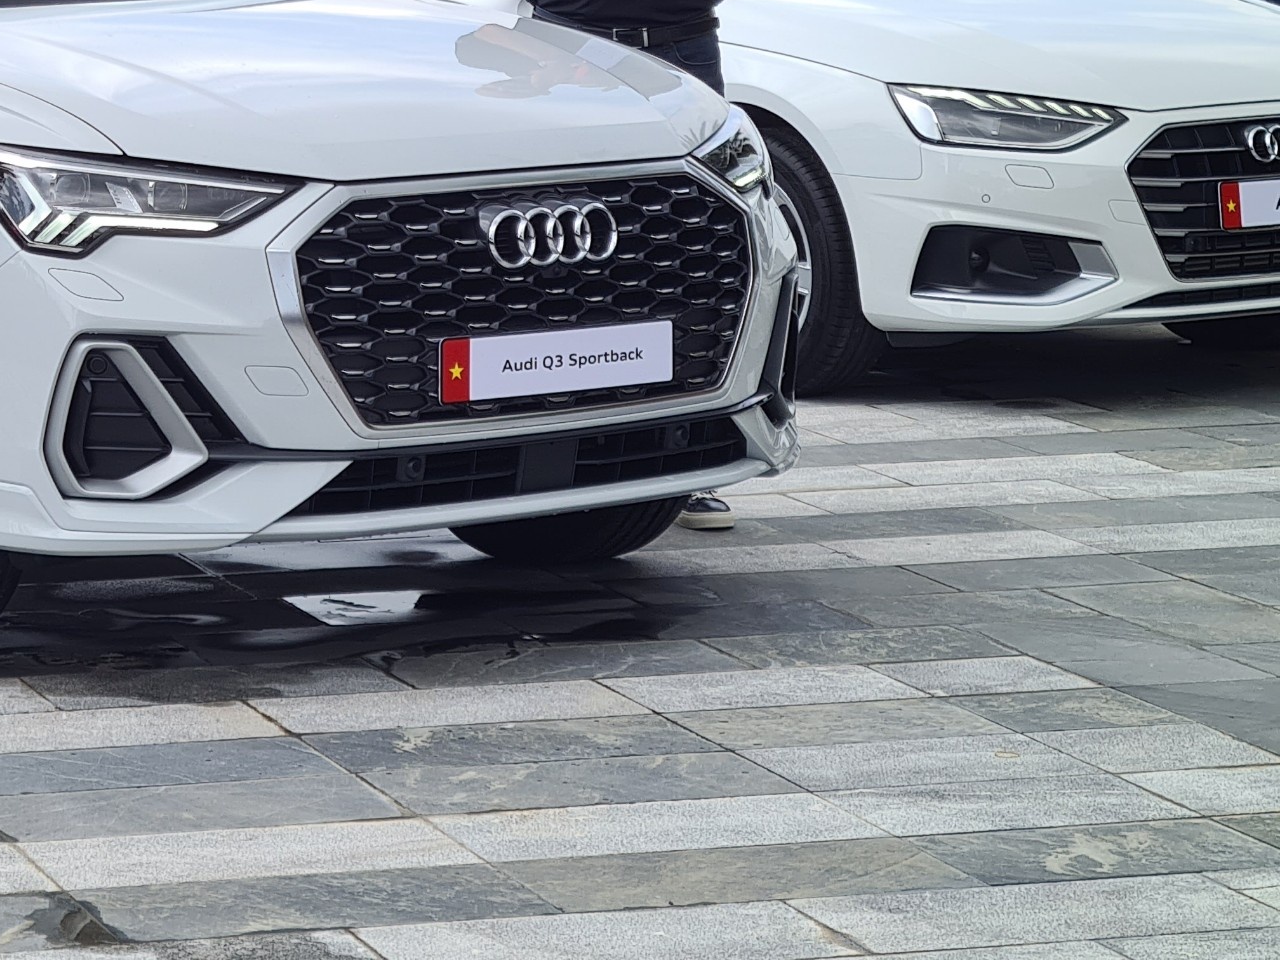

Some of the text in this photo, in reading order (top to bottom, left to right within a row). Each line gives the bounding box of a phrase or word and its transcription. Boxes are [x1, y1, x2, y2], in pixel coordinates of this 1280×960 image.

[502, 347, 644, 373] Audi Q3 Sportback
